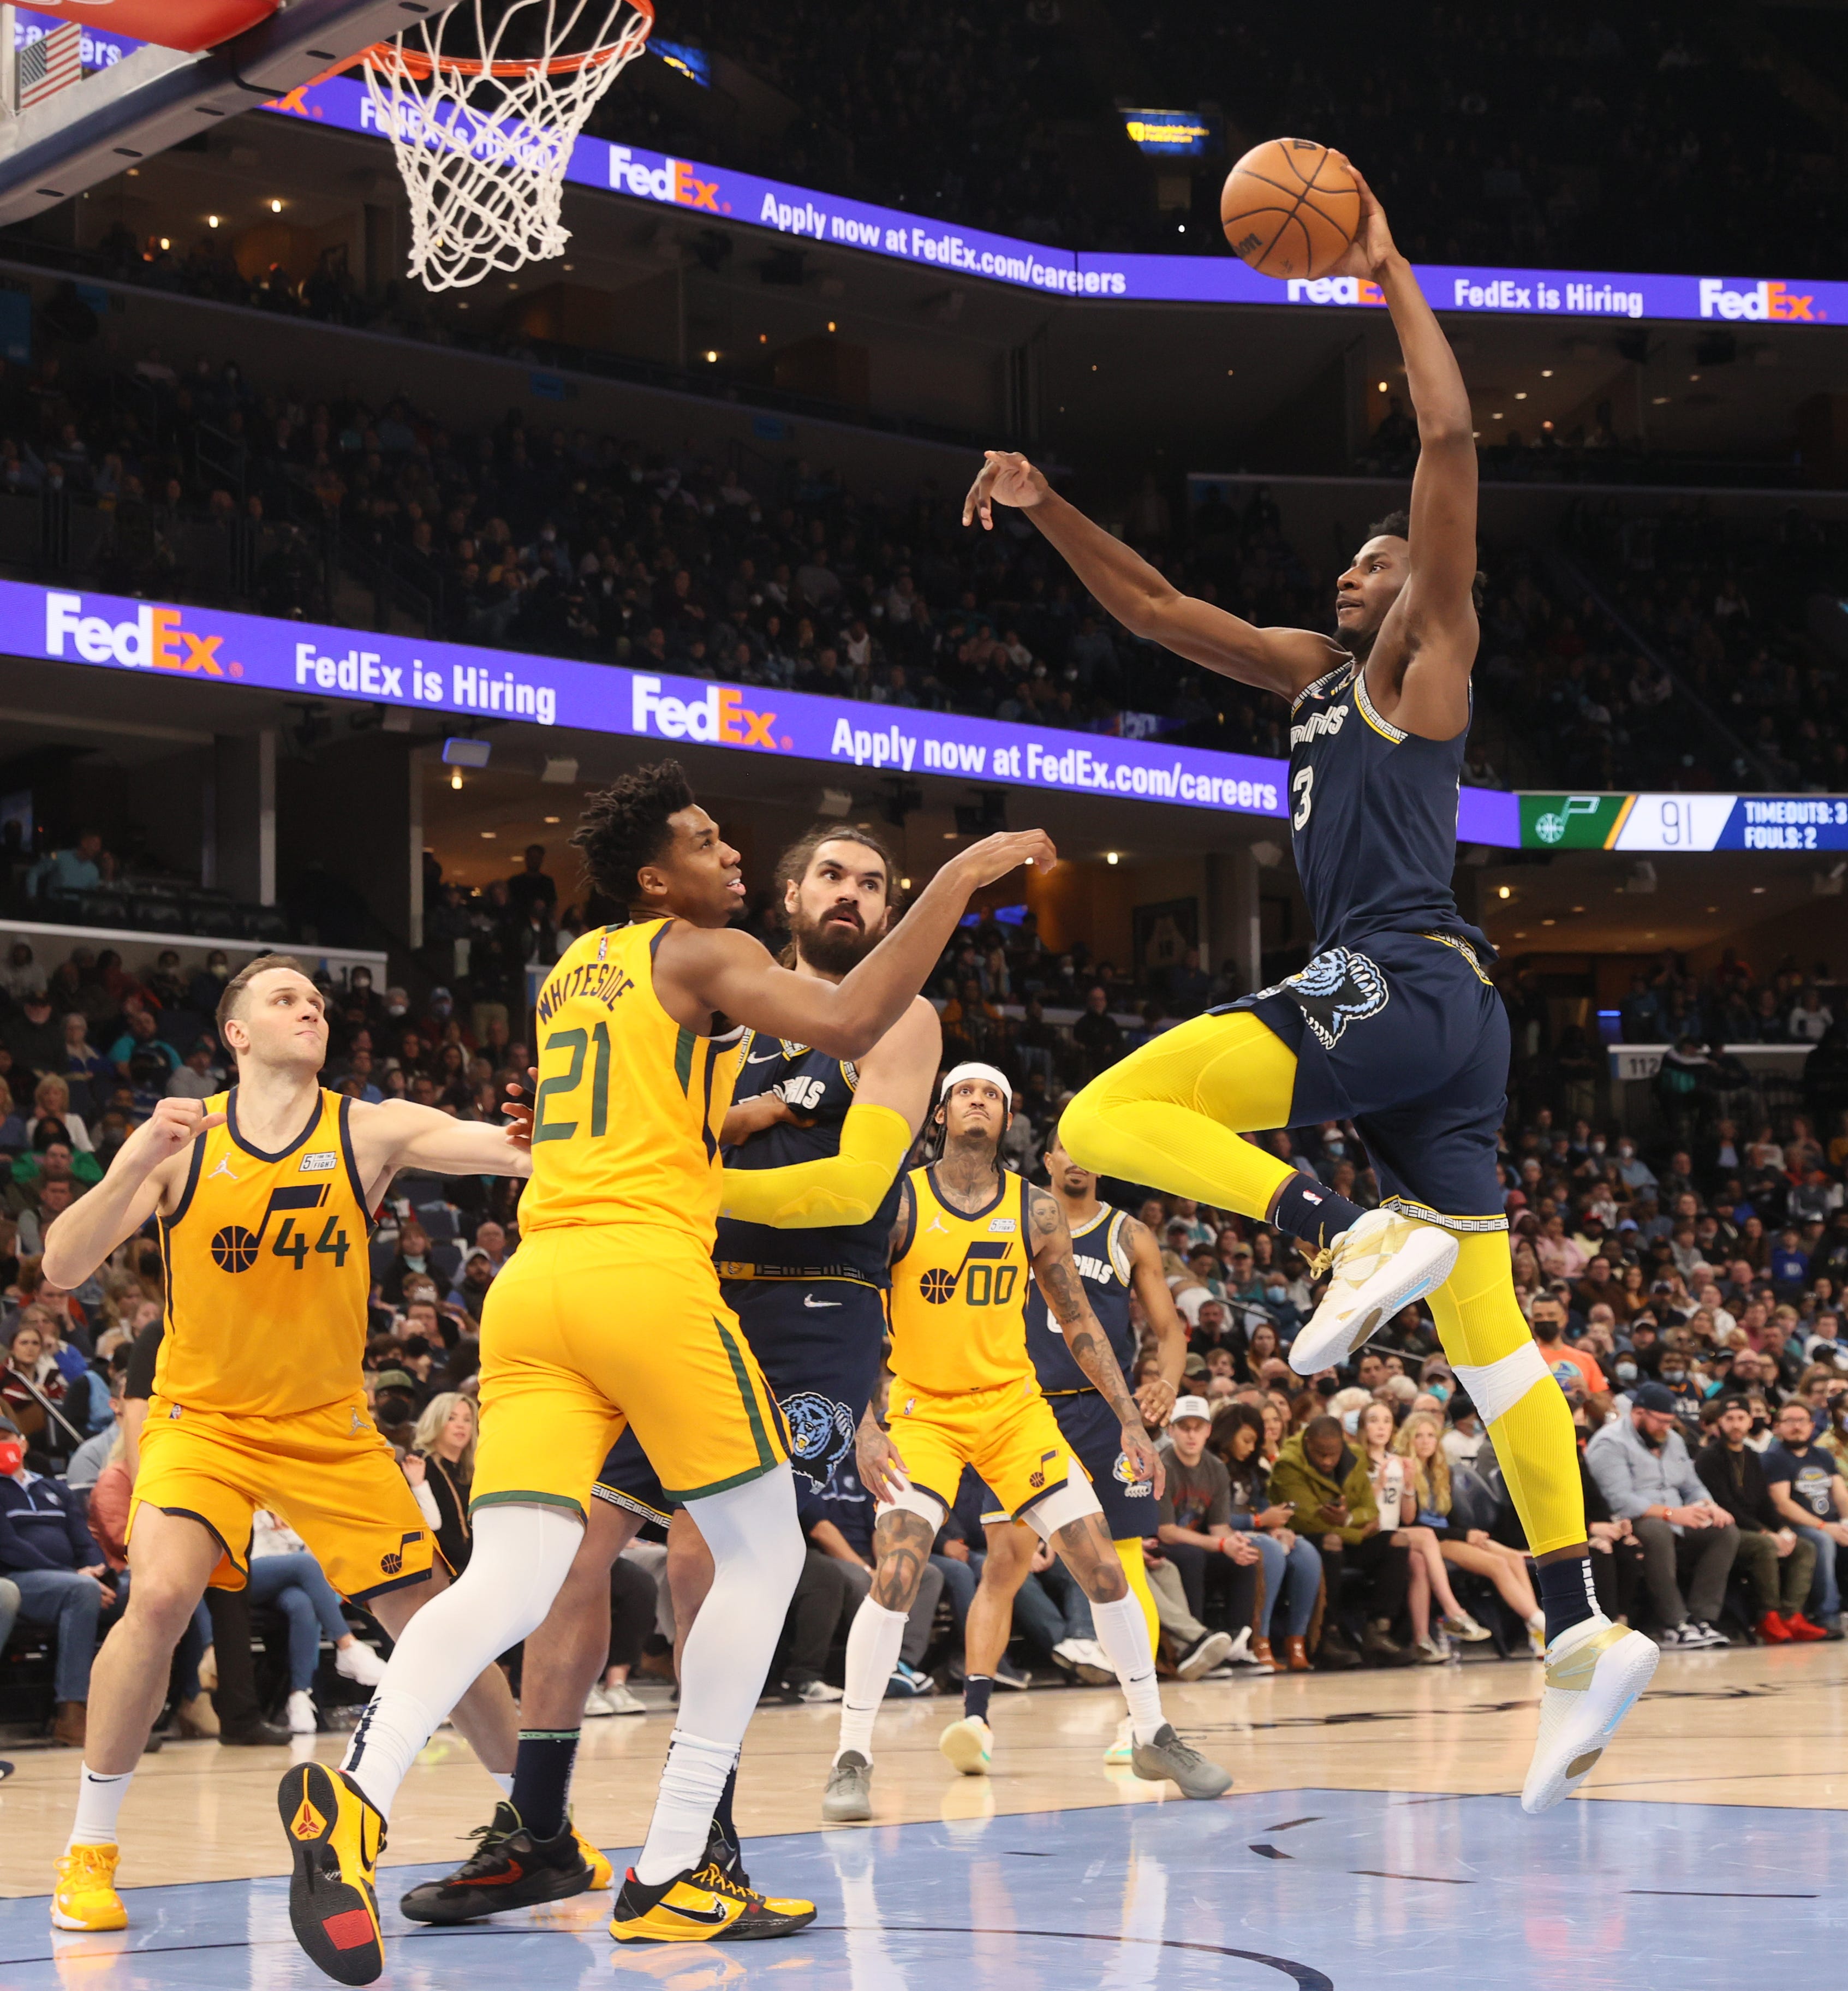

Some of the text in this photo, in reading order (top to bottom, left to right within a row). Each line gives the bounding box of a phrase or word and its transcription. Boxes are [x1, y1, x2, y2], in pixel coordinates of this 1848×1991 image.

[610, 145, 719, 212] FedEx
[761, 193, 1126, 294] Apply now at FedEx.com/careers
[1454, 279, 1643, 318] FedEx is Hiring
[1699, 278, 1814, 320] FedEx
[46, 592, 224, 676] FedEx
[295, 643, 556, 725] FedEx is Hiring
[632, 674, 776, 749] FedEx
[831, 718, 1278, 811] Apply now at FedEx.com/careers
[1661, 801, 1692, 845] 91
[1744, 801, 1847, 825] TIMEOUTS: 3
[1744, 826, 1817, 849] FOULS: 2
[537, 963, 635, 1025] WHITESIDE
[530, 1021, 611, 1146] 21
[303, 1156, 312, 1169] 5
[313, 1160, 333, 1169] FIGHT
[272, 1215, 350, 1270] 44
[966, 1265, 1018, 1306] 00
